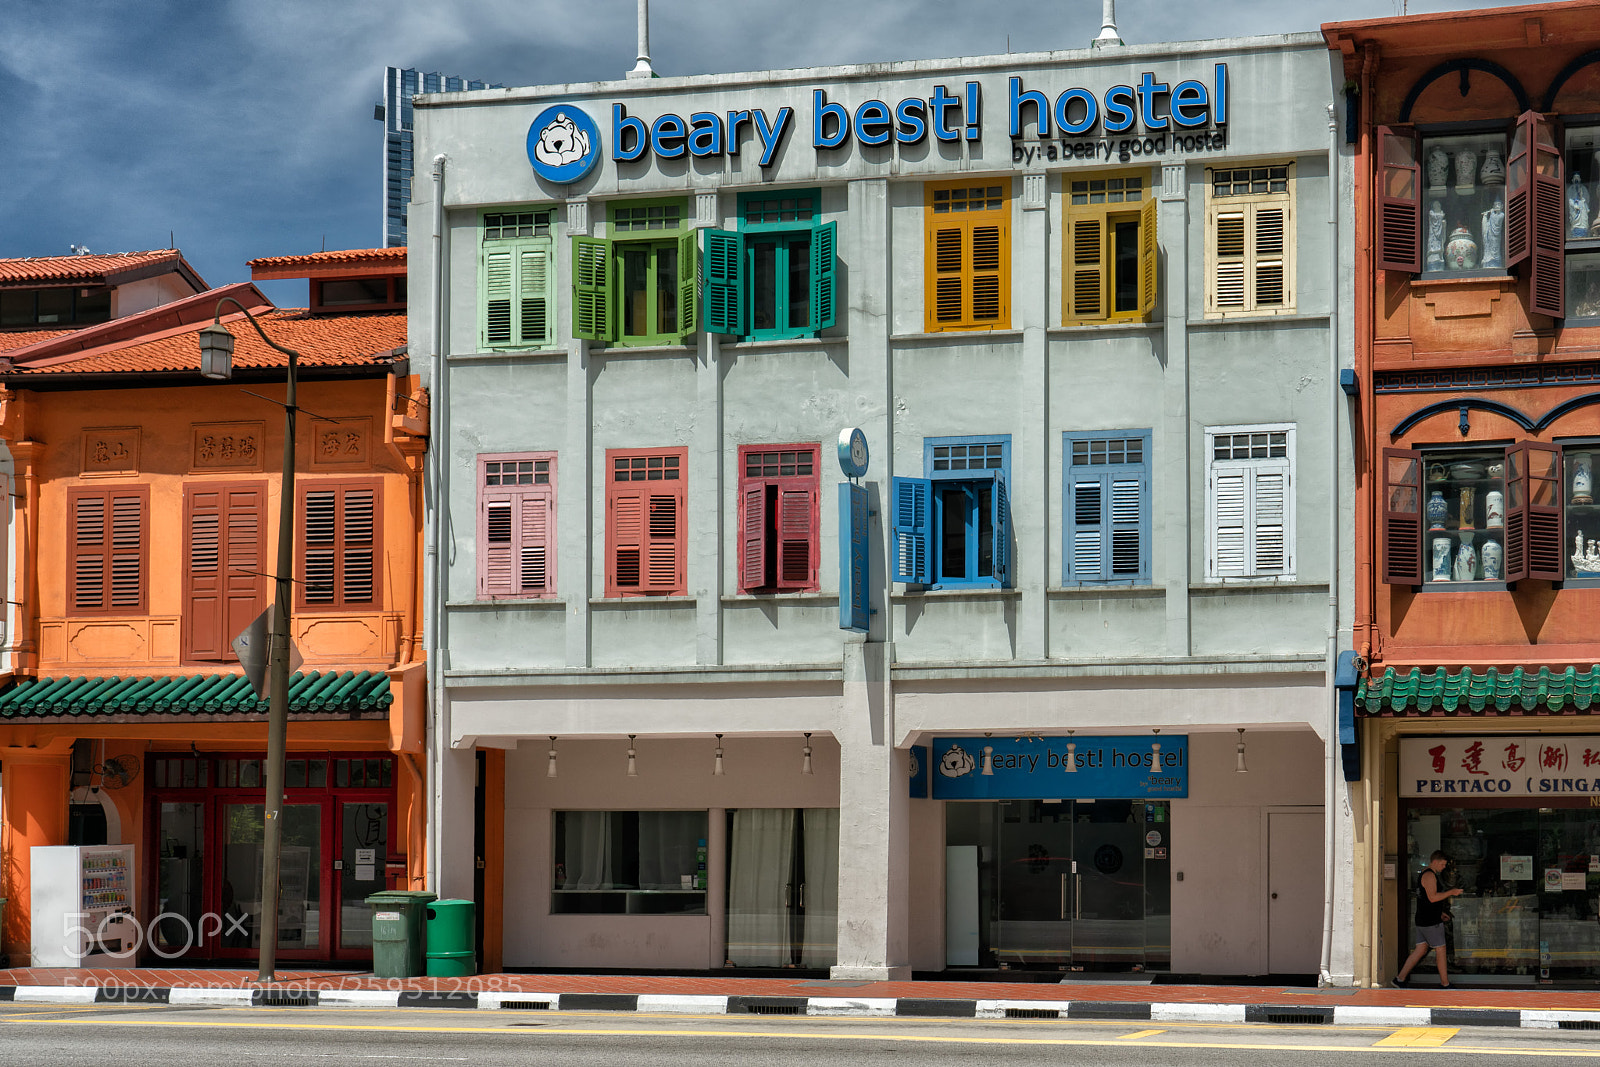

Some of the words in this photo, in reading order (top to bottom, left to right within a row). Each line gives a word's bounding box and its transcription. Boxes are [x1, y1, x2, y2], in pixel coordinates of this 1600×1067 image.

[612, 103, 792, 166] beary
[813, 82, 981, 150] best!
[1009, 64, 1227, 137] hostel
[1012, 143, 1041, 165] by:
[1047, 144, 1058, 160] a
[1062, 139, 1115, 162] beary
[1119, 133, 1166, 161] good
[1173, 129, 1228, 153] hostel
[1151, 775, 1182, 786] beary
[1416, 778, 1511, 793] PERTACO
